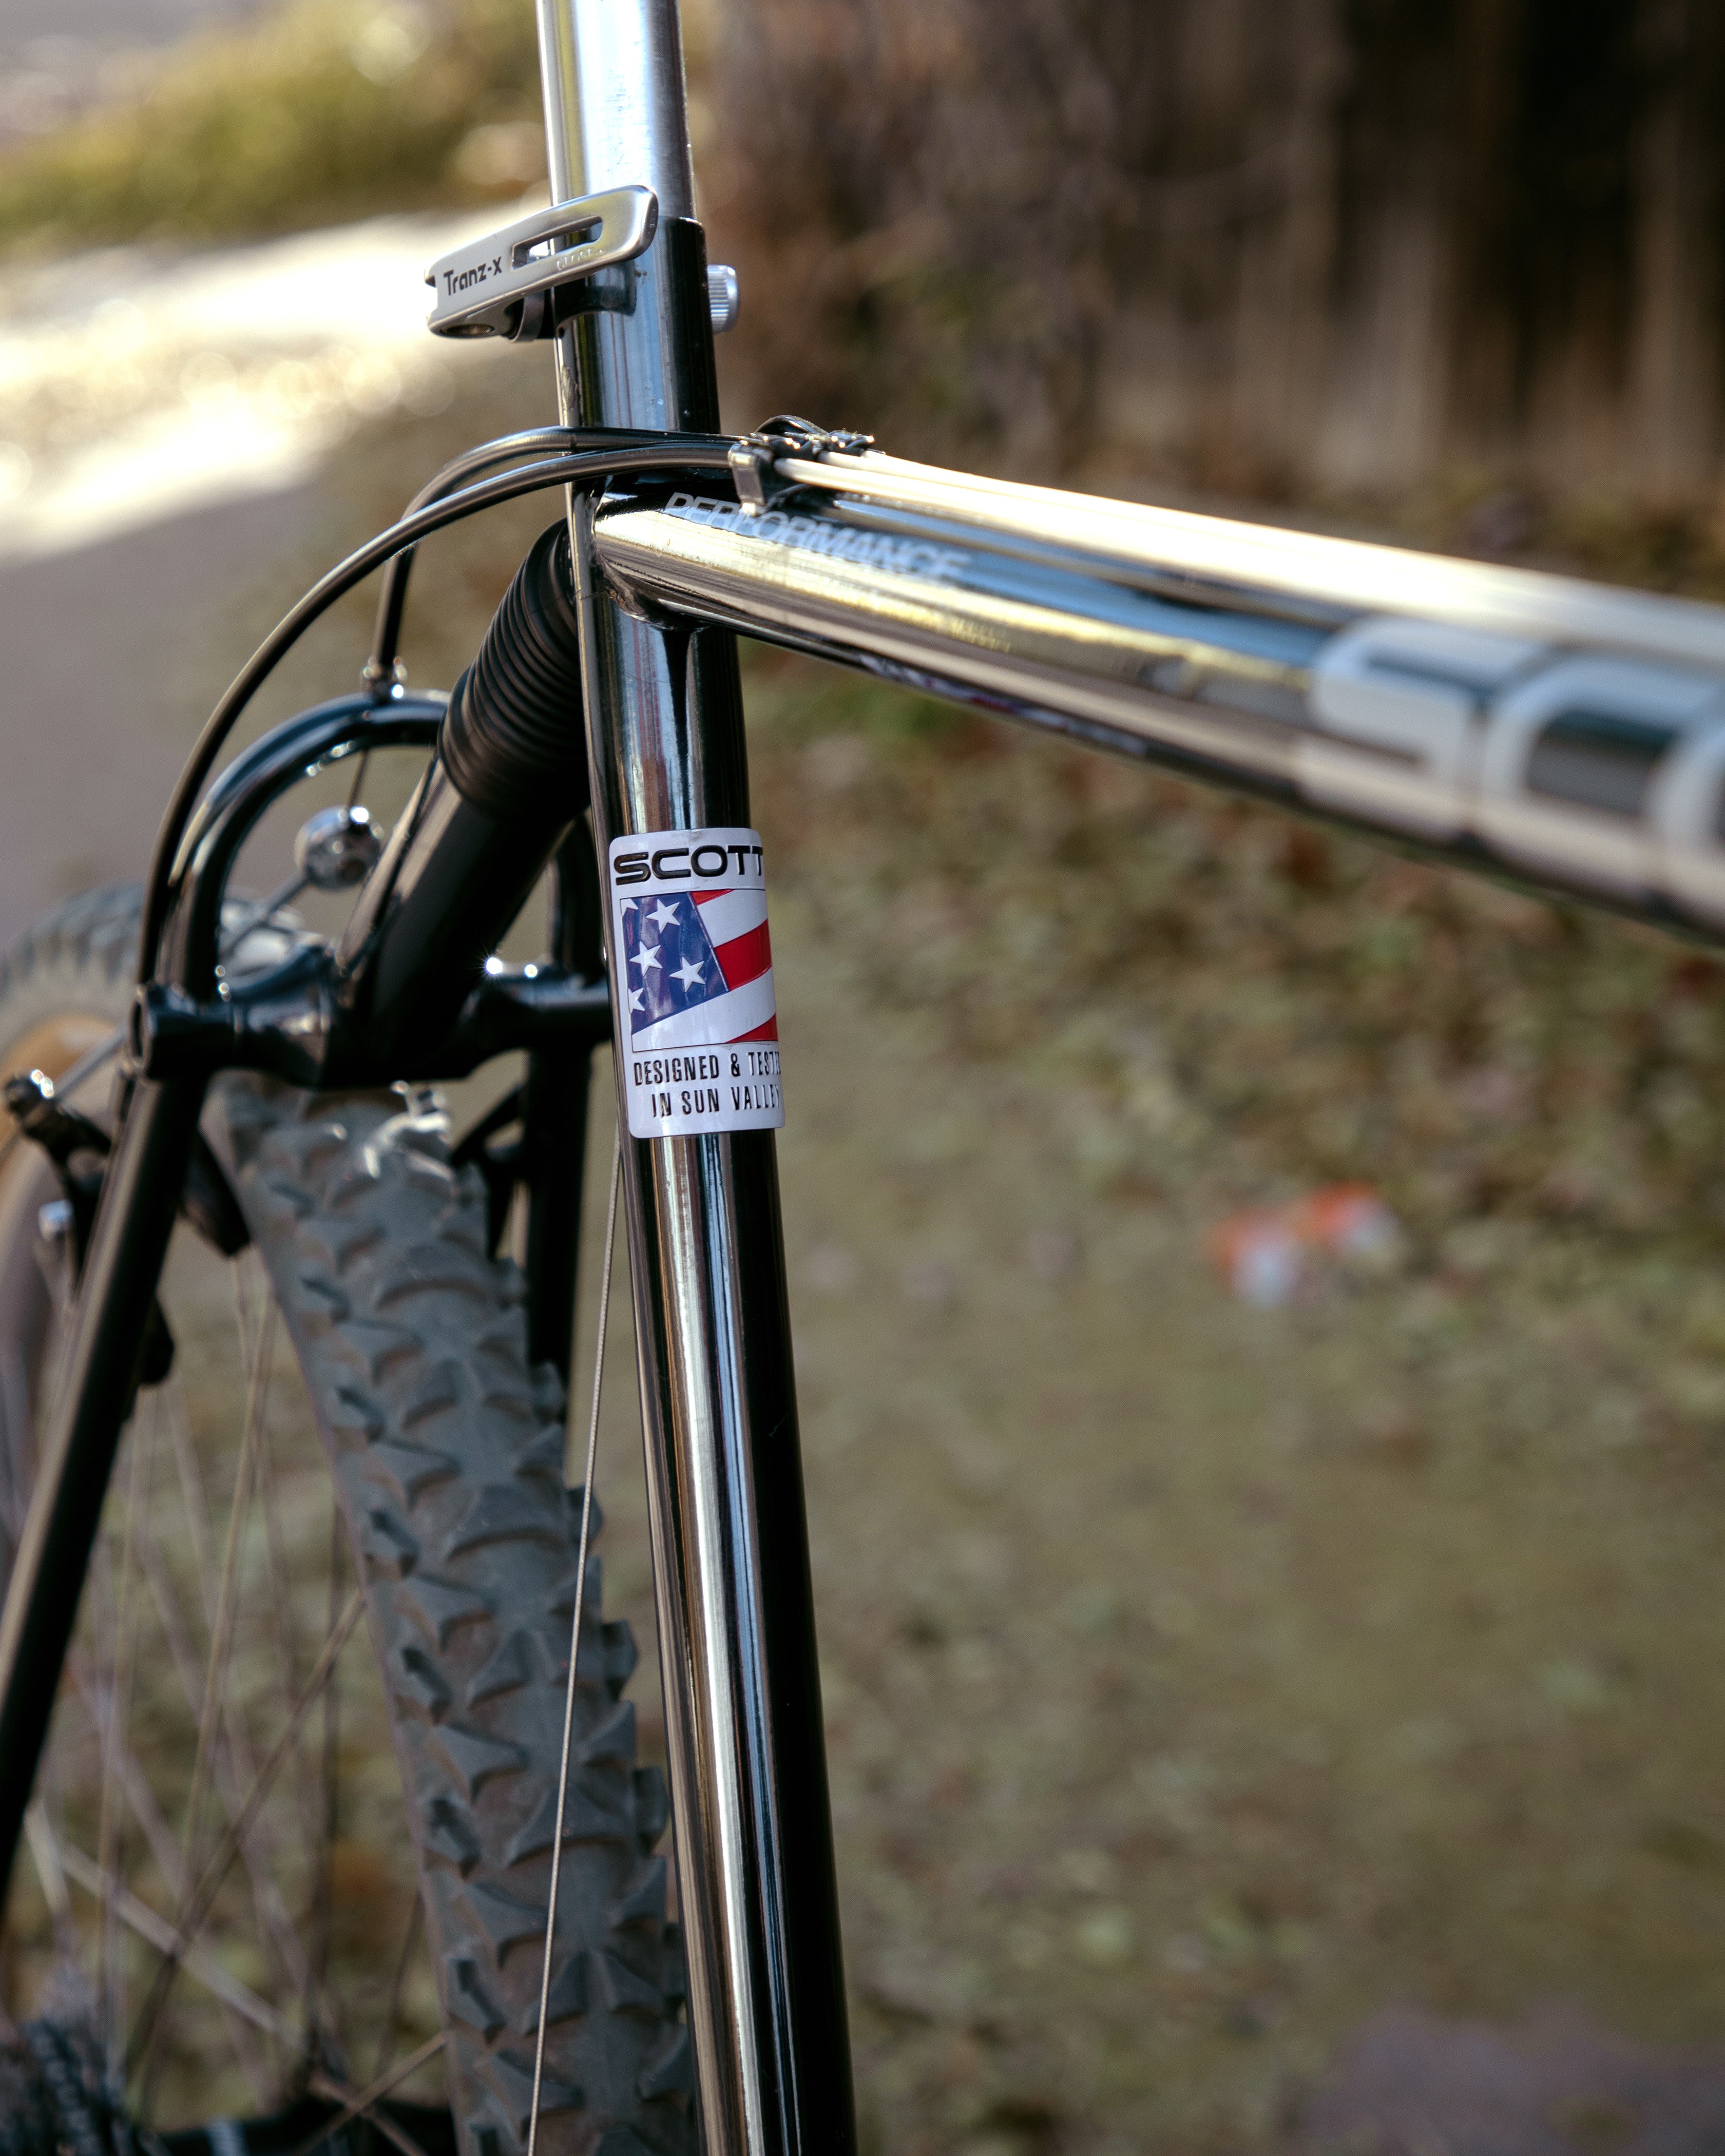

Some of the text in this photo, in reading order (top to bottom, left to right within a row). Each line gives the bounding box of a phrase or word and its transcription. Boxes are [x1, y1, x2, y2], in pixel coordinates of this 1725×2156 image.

[614, 844, 763, 886] SCOTT
[634, 1055, 719, 1086] DESIGNED
[730, 1053, 740, 1077] &
[651, 1092, 672, 1118] IN
[681, 1088, 720, 1114] SUN
